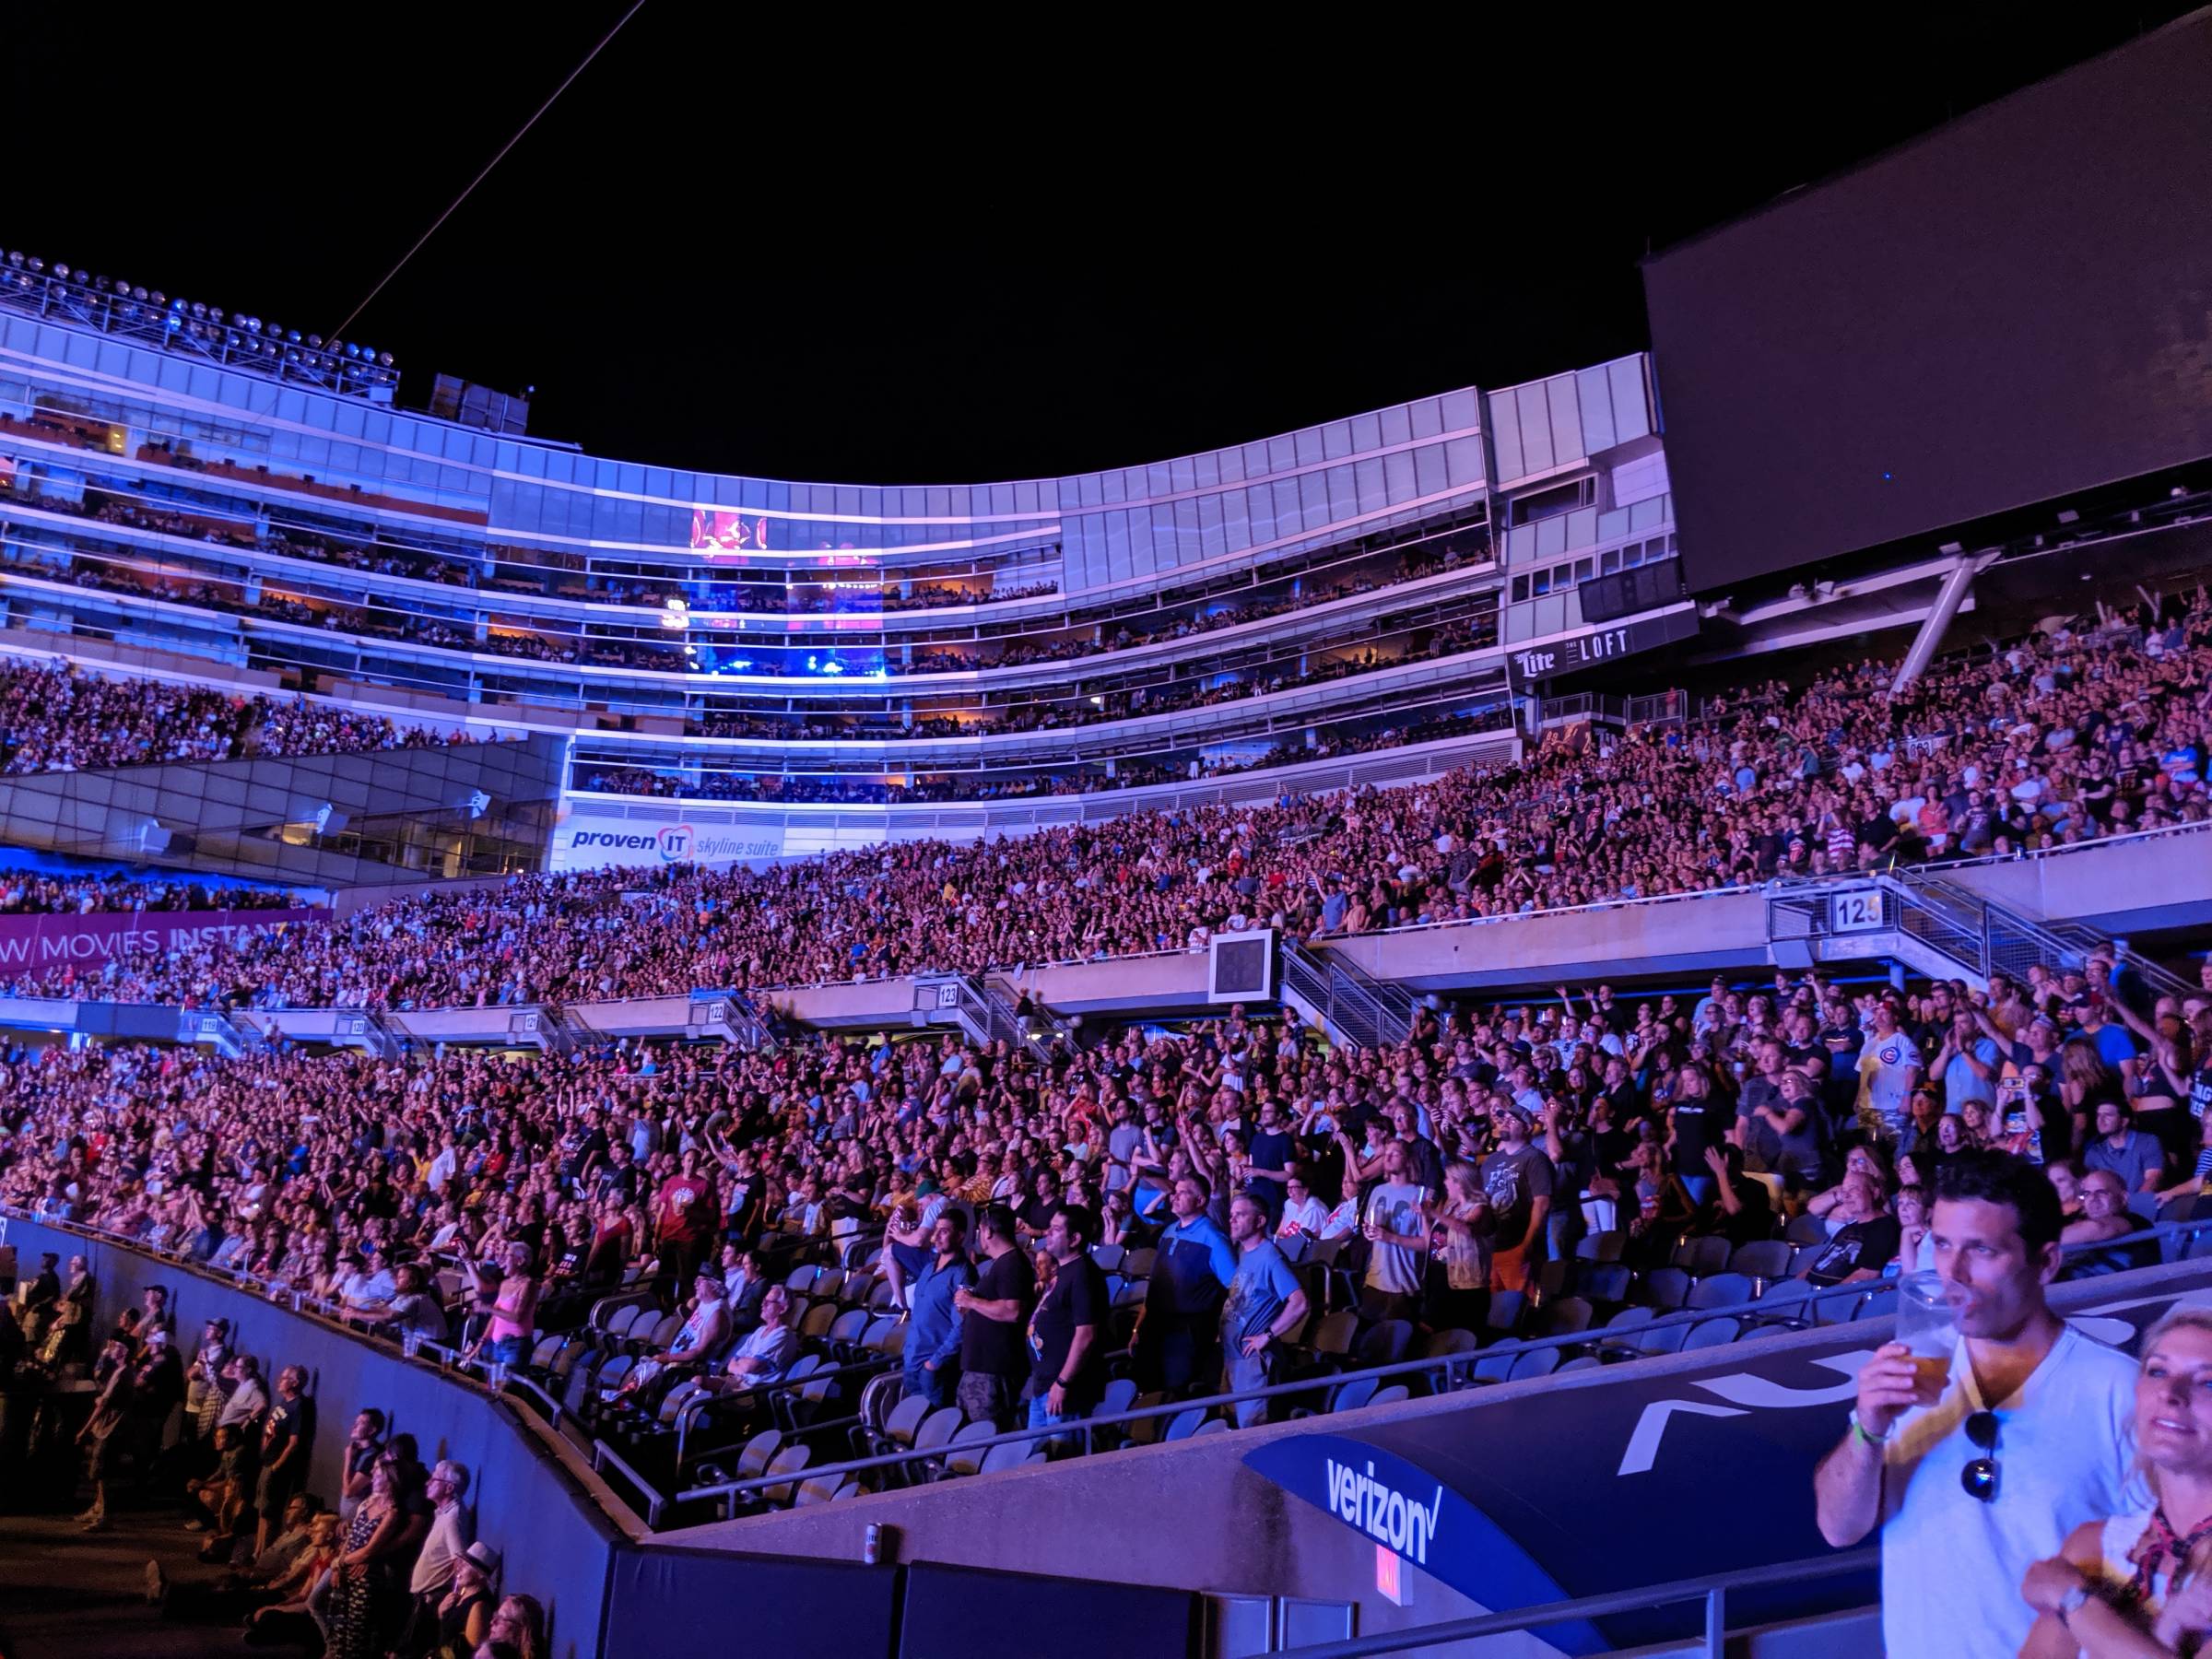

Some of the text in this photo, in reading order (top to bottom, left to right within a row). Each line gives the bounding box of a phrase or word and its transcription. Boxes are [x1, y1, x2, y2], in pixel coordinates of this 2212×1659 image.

[1580, 629, 1627, 661] LOFT
[1523, 652, 1556, 678] Lite
[571, 830, 779, 857] proven IT skyline suite
[1838, 895, 1881, 925] 125
[41, 929, 159, 960] MOVIES
[941, 987, 957, 1003] 123
[204, 1018, 217, 1030] 119
[526, 1018, 536, 1029] 121
[710, 1005, 724, 1019] 122
[353, 1021, 364, 1033] 120
[1327, 1458, 1427, 1565] verizon
